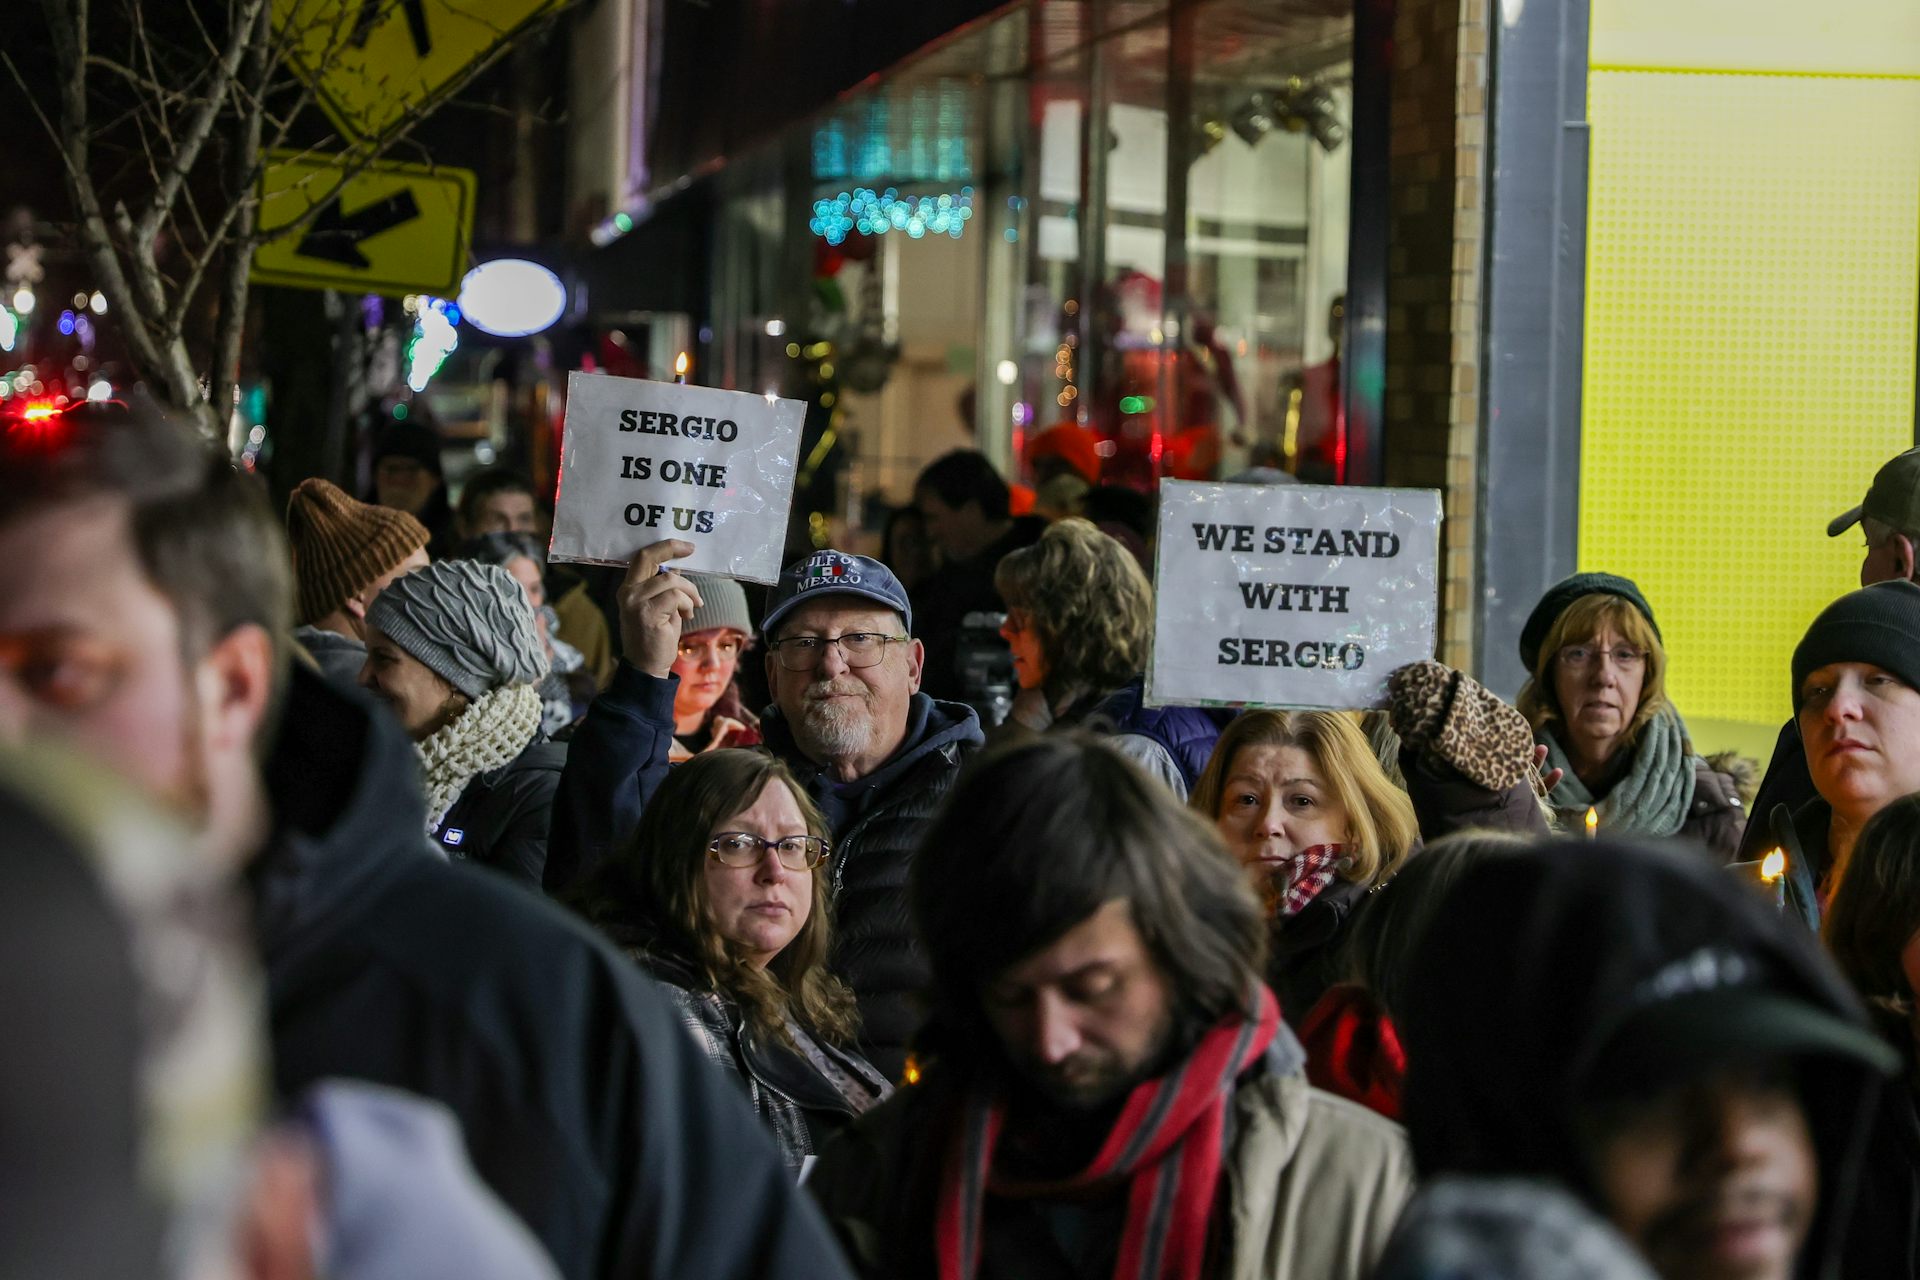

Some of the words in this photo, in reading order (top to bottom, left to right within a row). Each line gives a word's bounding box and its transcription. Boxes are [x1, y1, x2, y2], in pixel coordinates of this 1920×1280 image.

[619, 409, 738, 443] SERGIO
[620, 456, 652, 480] IS
[660, 459, 727, 489] ONE
[624, 503, 665, 528] OF
[672, 507, 715, 534] US
[1192, 522, 1255, 553] WE
[1264, 526, 1400, 559] STAND
[796, 574, 862, 594] MEXICO
[1239, 582, 1350, 613] WITH
[1218, 637, 1365, 671] SERGIO
